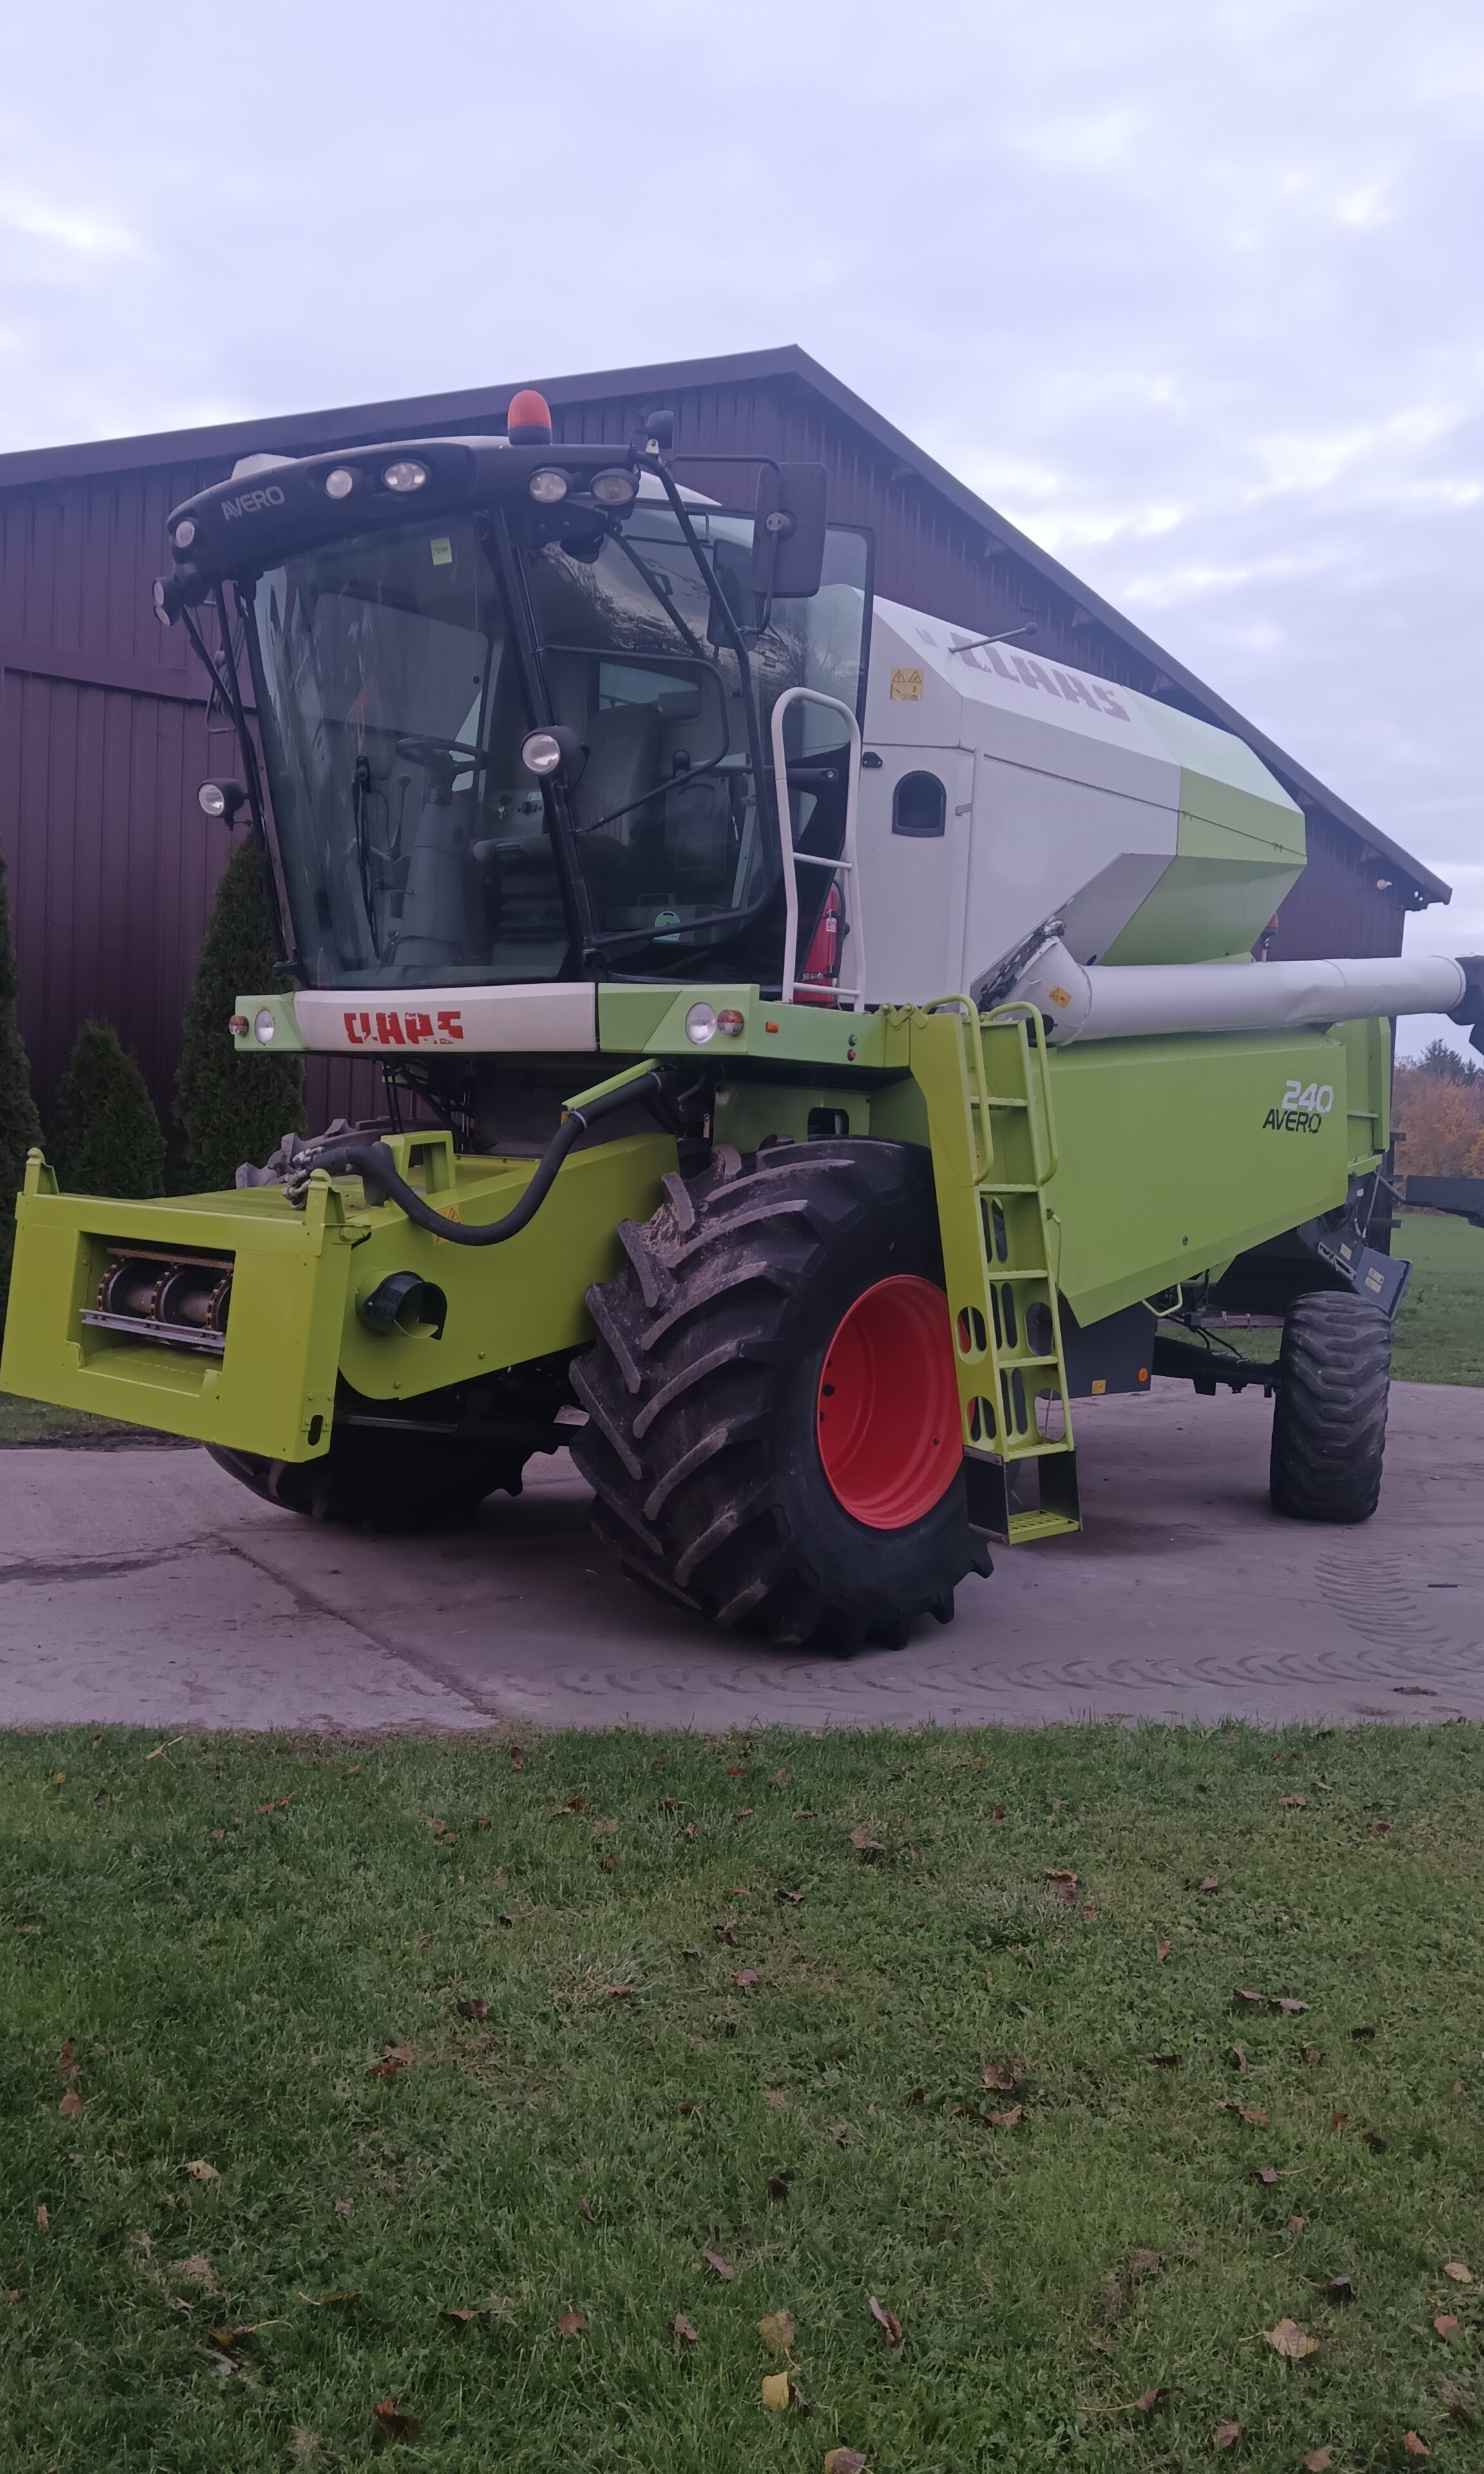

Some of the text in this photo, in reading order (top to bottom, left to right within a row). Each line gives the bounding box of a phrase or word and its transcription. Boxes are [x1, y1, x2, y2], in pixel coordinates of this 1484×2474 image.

[221, 486, 285, 521] AVERO
[1282, 1080, 1334, 1113] 240
[1262, 1109, 1322, 1133] AVERO
